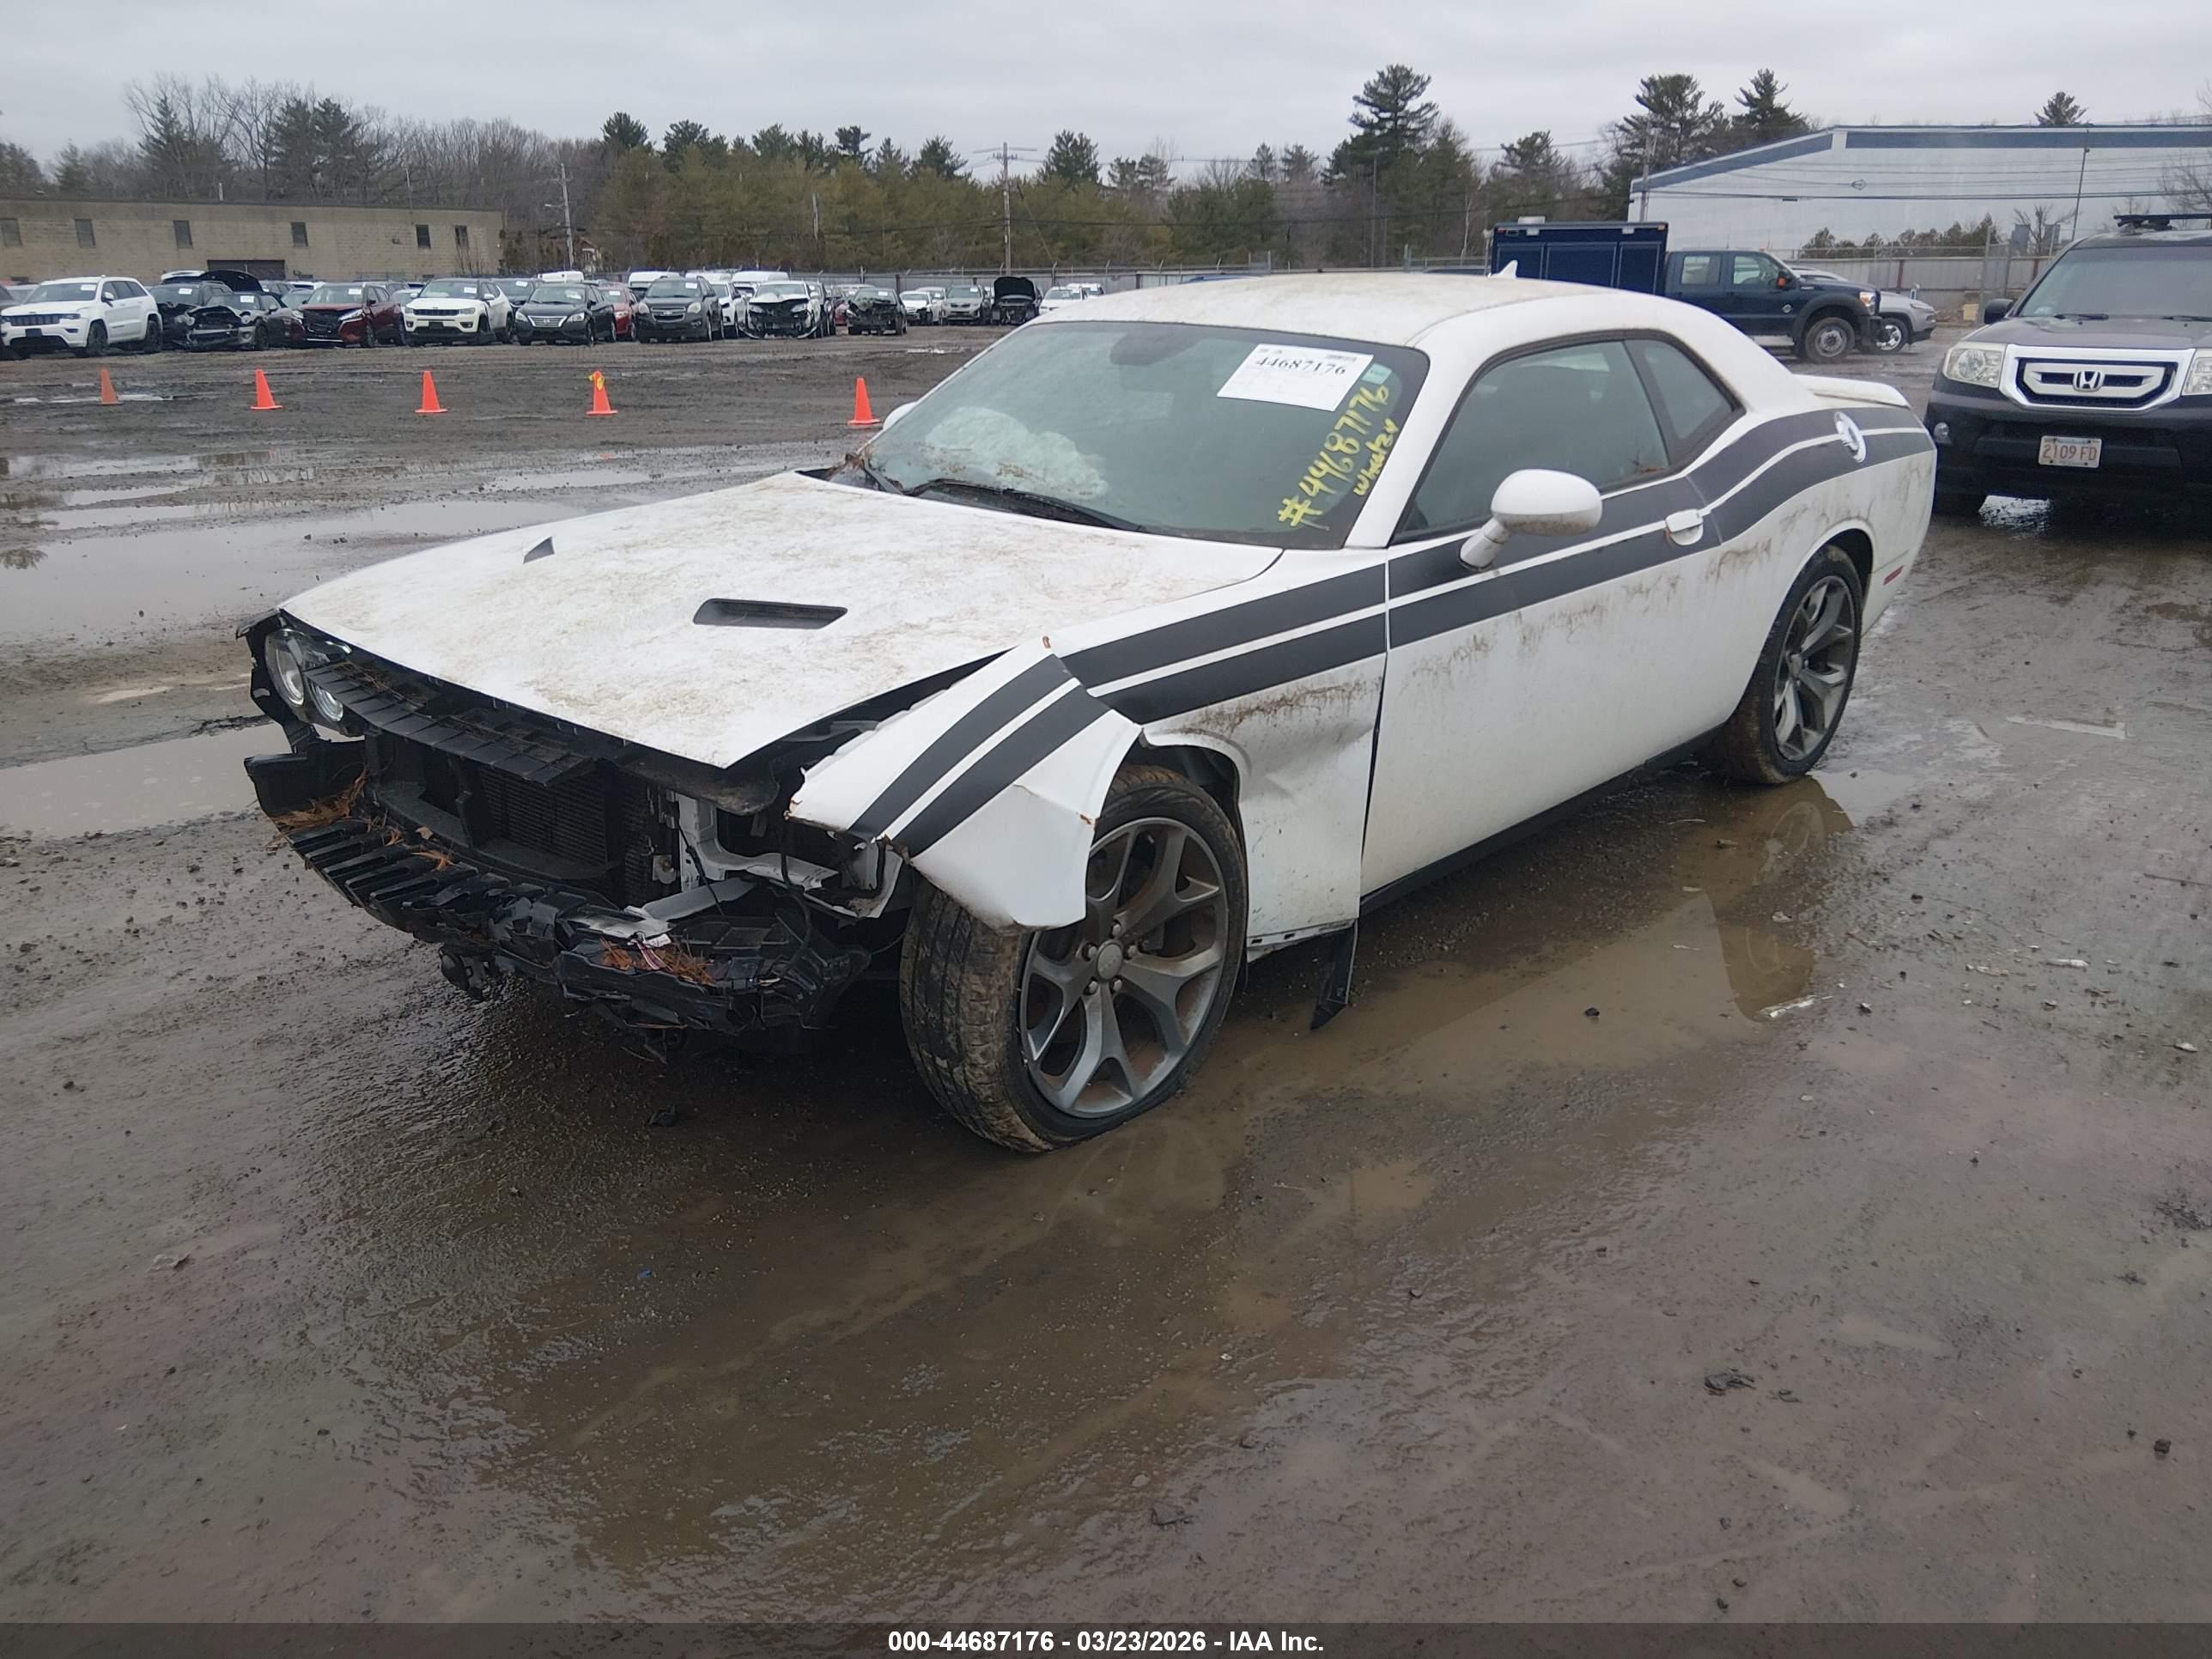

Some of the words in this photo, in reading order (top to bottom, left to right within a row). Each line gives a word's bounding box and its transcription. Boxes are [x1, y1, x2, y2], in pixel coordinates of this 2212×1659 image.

[1256, 356, 1346, 375] 44687176
[2043, 445, 2076, 459] 2109
[2081, 447, 2097, 461] FD
